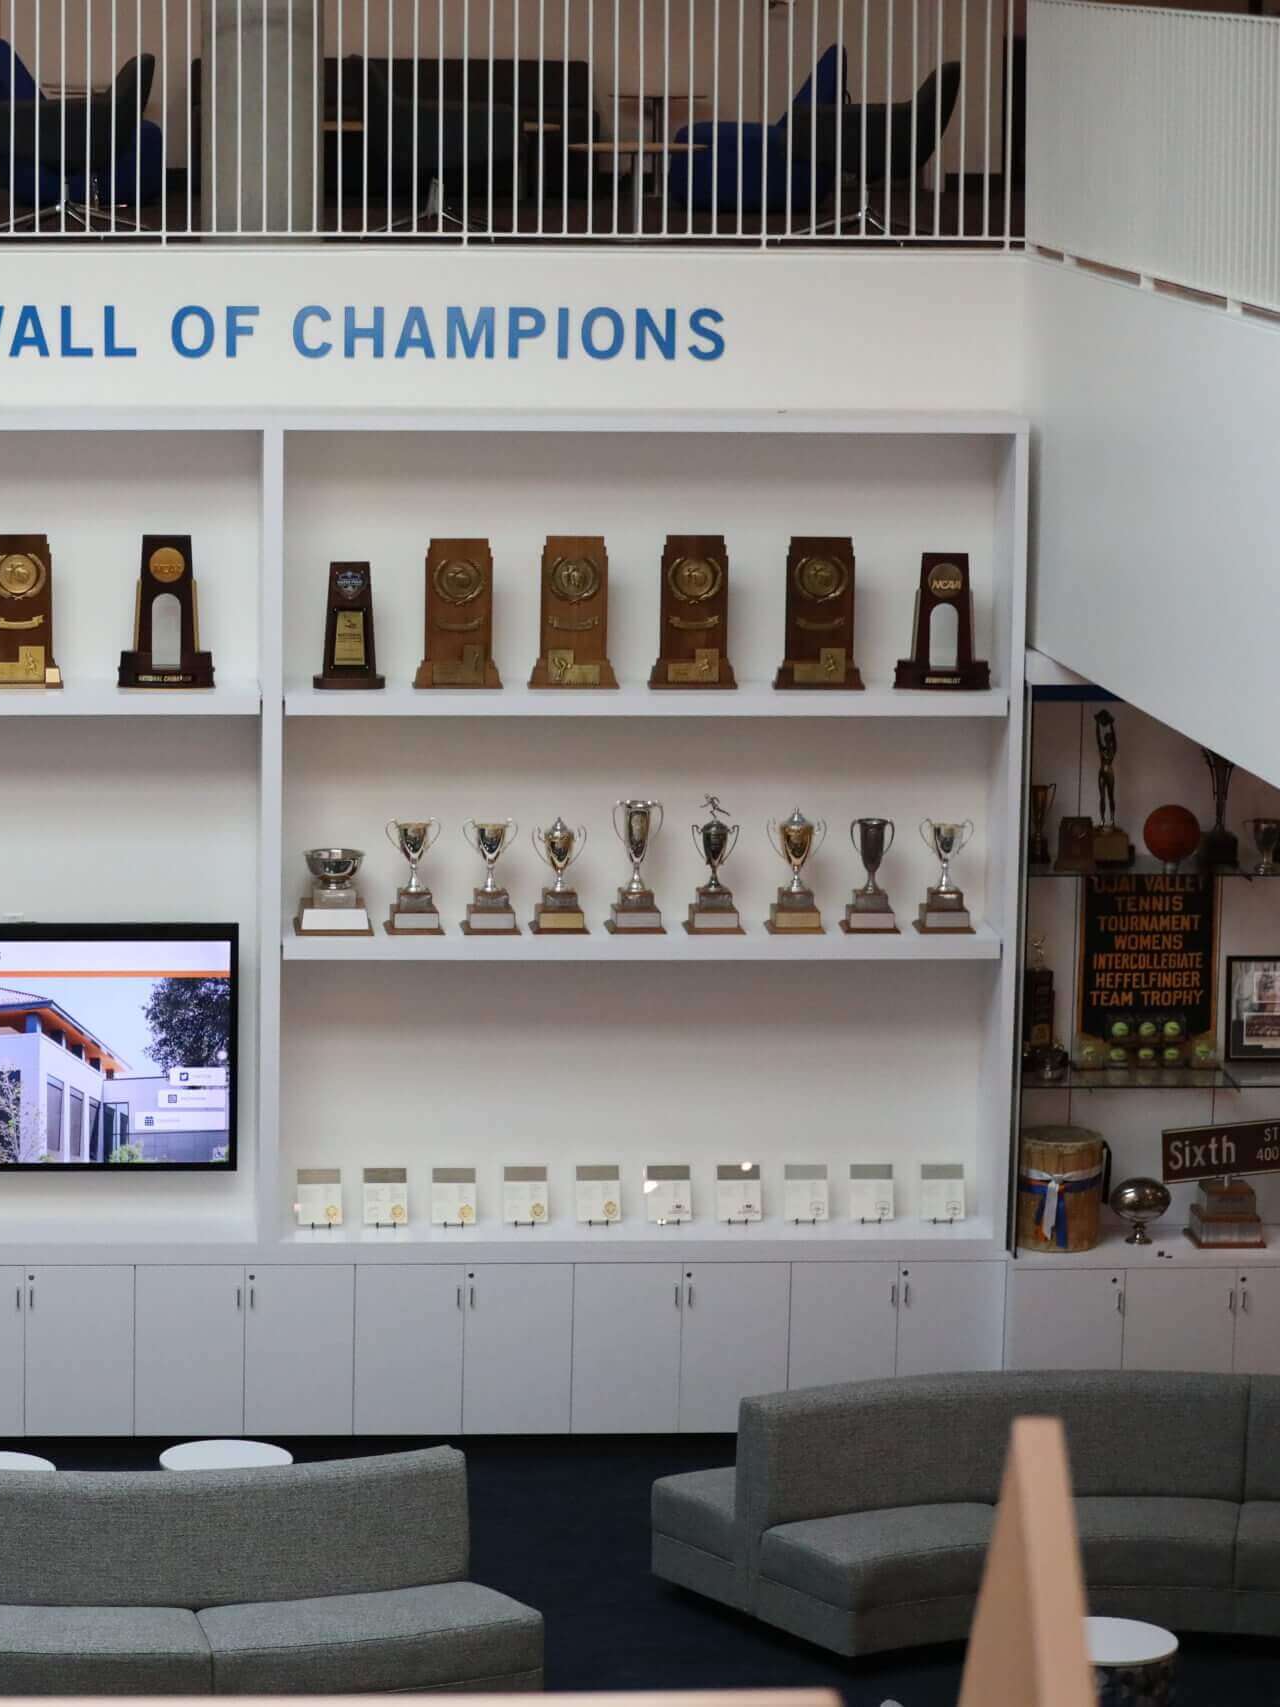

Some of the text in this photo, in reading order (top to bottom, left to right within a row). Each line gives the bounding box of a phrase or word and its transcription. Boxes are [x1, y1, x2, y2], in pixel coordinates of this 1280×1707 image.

[170, 305, 260, 358] OF
[292, 305, 726, 361] CHAMPIONS
[931, 579, 961, 590] NCAA
[1116, 895, 1184, 912] TENNIS
[1097, 914, 1201, 932] TOURNAMENT
[1114, 934, 1184, 950] WOMENS
[1093, 952, 1203, 970] INTERCOLLEGIATE
[1096, 971, 1201, 989] HEFFELFINGER
[1090, 990, 1204, 1007] TEAM TROPHY
[1263, 1127, 1280, 1142] ST
[1169, 1135, 1237, 1170] Sixth
